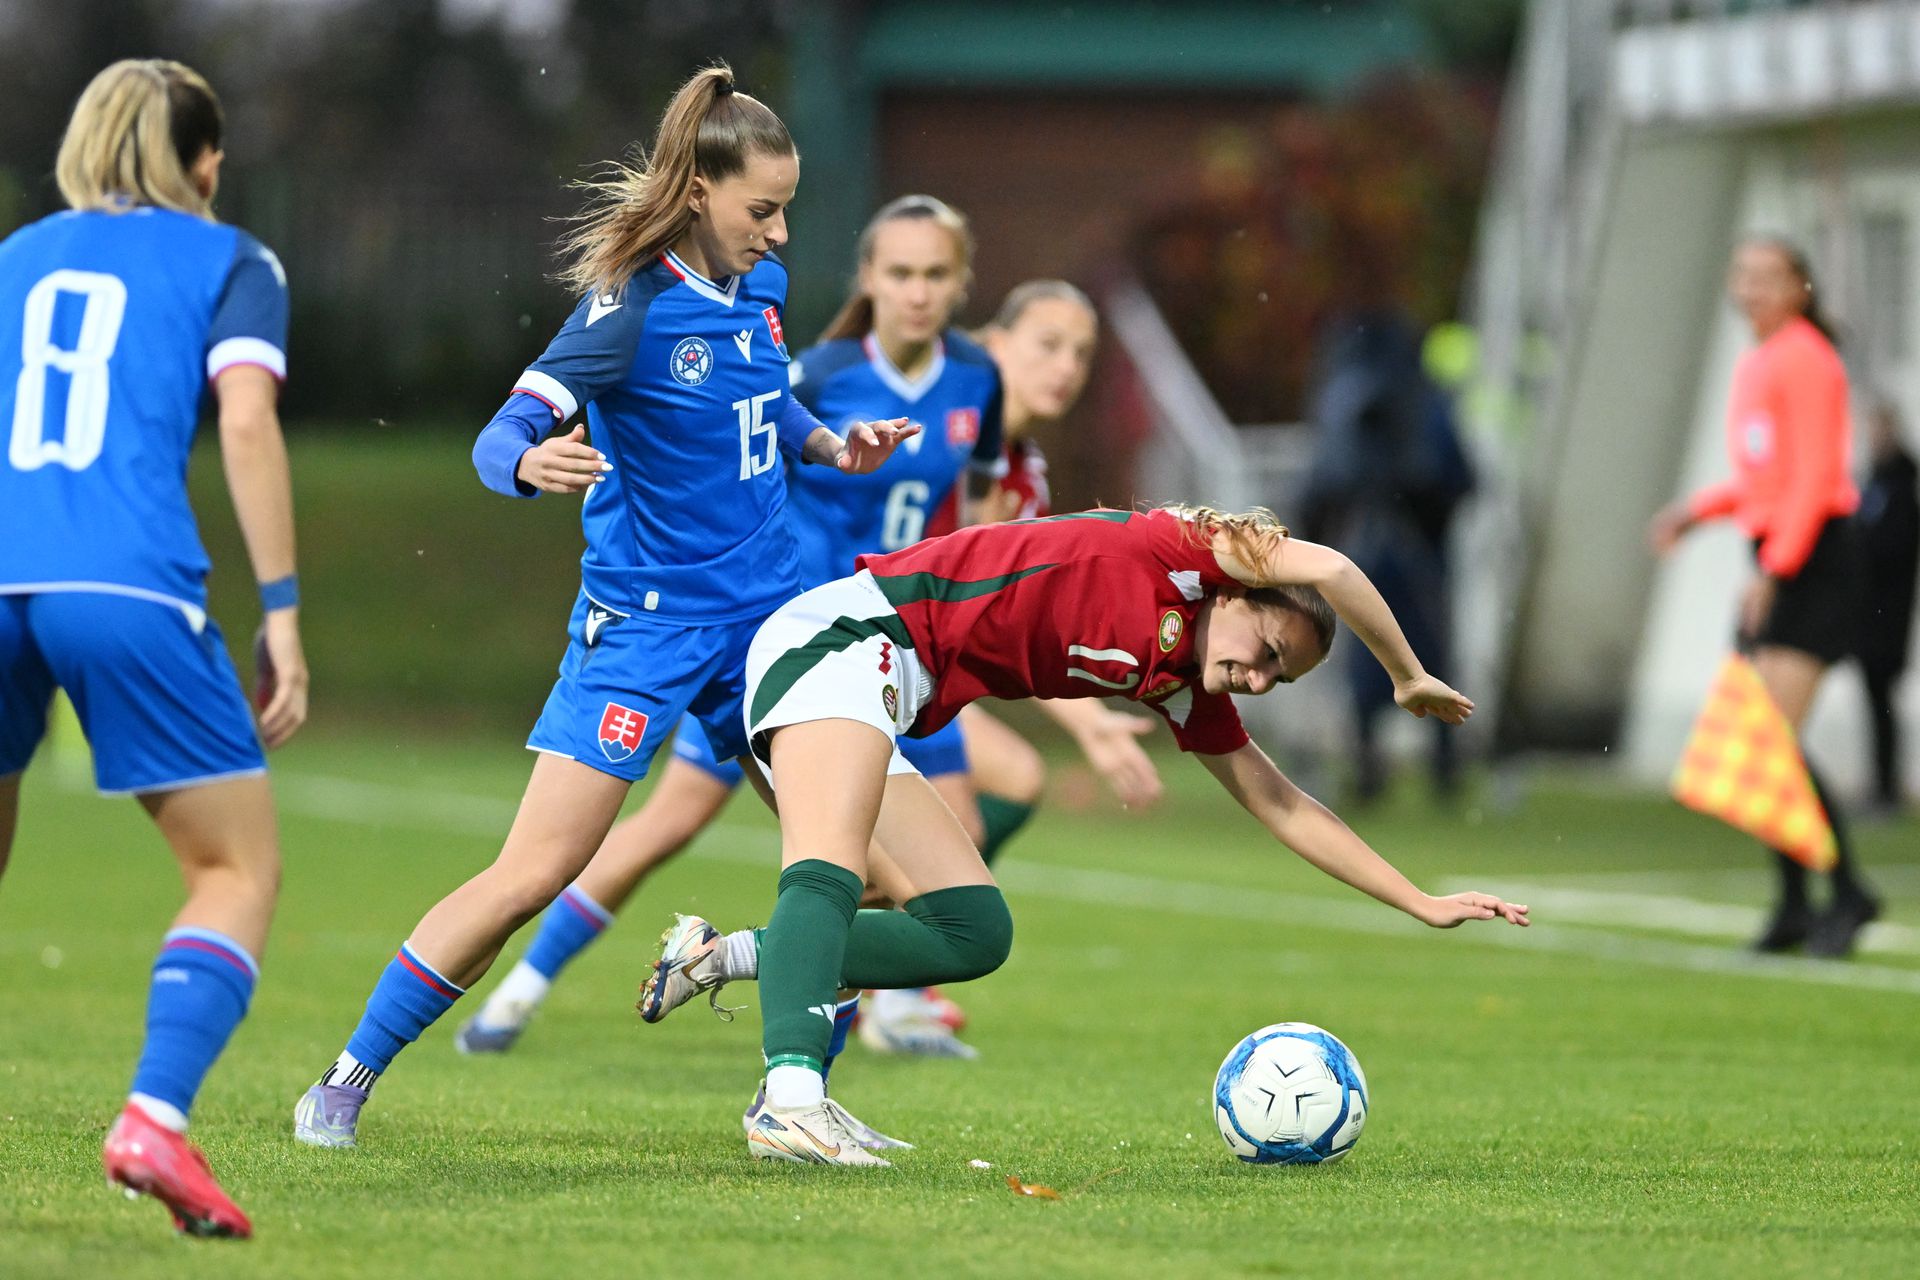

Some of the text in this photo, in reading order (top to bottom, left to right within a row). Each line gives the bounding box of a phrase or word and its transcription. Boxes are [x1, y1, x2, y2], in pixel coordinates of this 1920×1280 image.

[8, 268, 128, 472] 8
[732, 389, 782, 481] 15
[880, 480, 930, 551] 6
